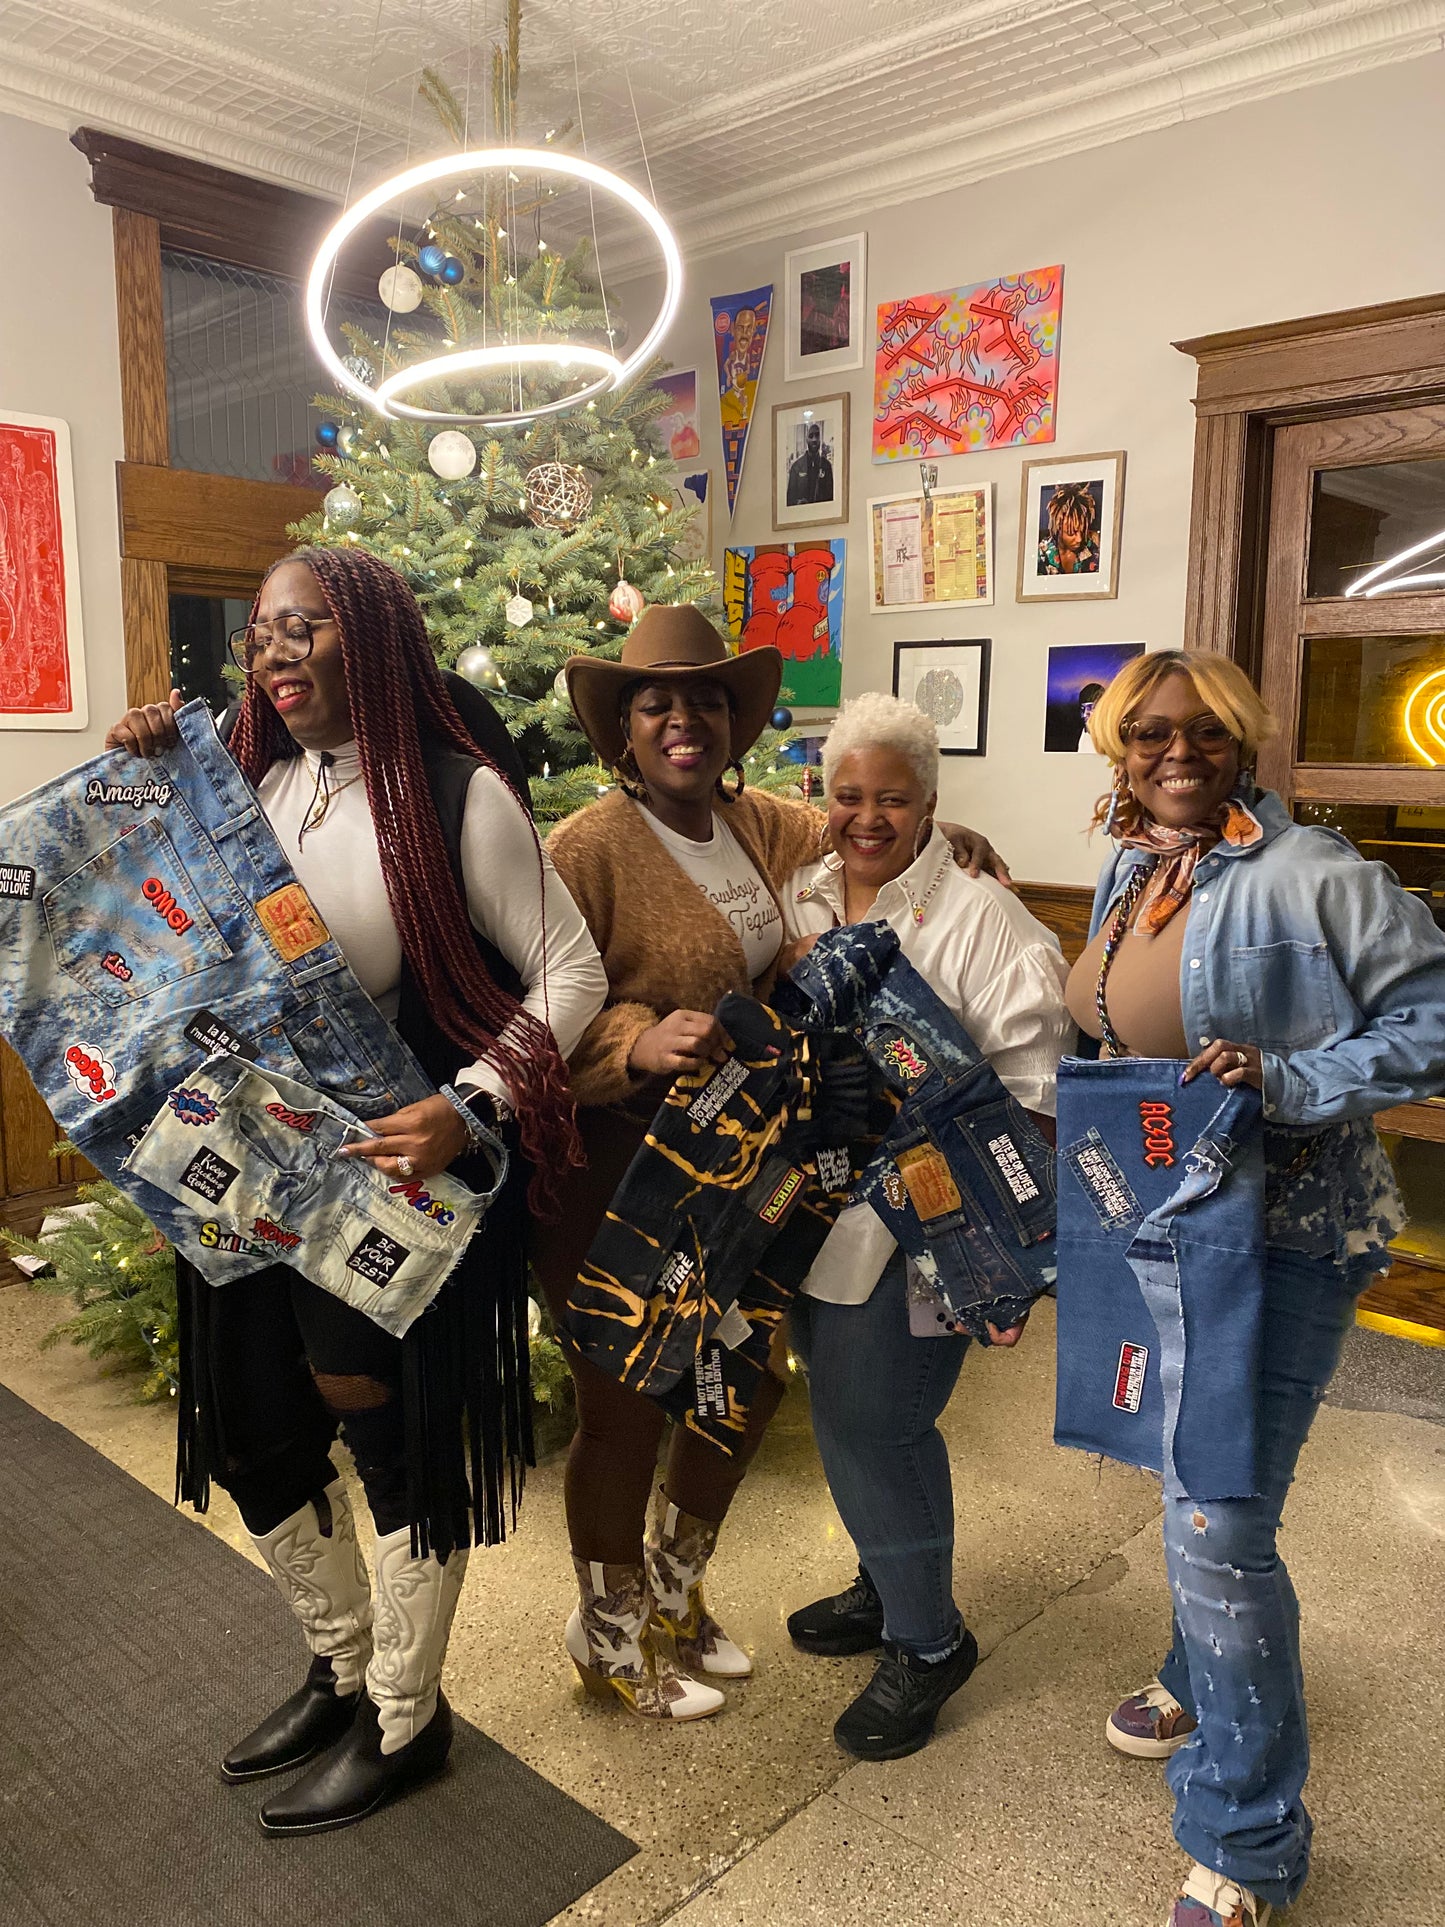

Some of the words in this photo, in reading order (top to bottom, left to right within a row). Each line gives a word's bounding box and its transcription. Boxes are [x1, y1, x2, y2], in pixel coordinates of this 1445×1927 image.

[87, 779, 172, 809] Amazing
[13, 868, 31, 883] LIVE
[0, 880, 9, 893] OU
[9, 881, 29, 896] LOVE
[141, 877, 195, 936] OMG!
[728, 895, 779, 941] Tequil
[200, 1033, 216, 1048] not
[206, 1022, 221, 1038] la
[216, 1029, 232, 1045] la
[227, 1038, 242, 1053] la
[688, 1091, 709, 1115] DIDN'T
[693, 1109, 705, 1122] TO
[700, 1081, 728, 1113] IMPRESS
[265, 1102, 315, 1132] COOL
[698, 1117, 709, 1128] OF
[704, 1107, 717, 1121] YOU
[987, 1138, 1003, 1155] ONLY
[996, 1132, 1015, 1154] HATE
[1081, 1148, 1090, 1157] IN
[198, 1151, 231, 1181] Keep
[994, 1151, 1009, 1167] GOD
[1005, 1148, 1020, 1163] ME
[1010, 1158, 1025, 1173] OR
[1075, 1152, 1094, 1177] KILLED
[1084, 1154, 1095, 1166] MY
[1000, 1163, 1015, 1178] CAN
[1015, 1168, 1034, 1189] LOVE
[1088, 1148, 1102, 1164] MAY
[1097, 1162, 1112, 1181] LOOK
[1106, 1178, 1122, 1198] CALM
[1117, 1195, 1130, 1211] BUT
[1090, 1163, 1104, 1180] HEAD
[184, 1170, 220, 1200] Going
[1005, 1173, 1024, 1195] JUDGE
[1024, 1184, 1039, 1199] ME
[1089, 1175, 1103, 1192] YOU
[1097, 1189, 1105, 1197] 3
[762, 1171, 802, 1220] FASHION
[1015, 1190, 1029, 1204] ME
[1100, 1195, 1117, 1217] TIMES
[1104, 1188, 1124, 1214] ALREADY
[375, 1235, 397, 1254] BE
[357, 1242, 396, 1273] YOUR
[347, 1254, 390, 1285] BEST
[664, 1253, 695, 1294] FIRE
[710, 1348, 722, 1381] EDITION
[1122, 1346, 1133, 1364] BAD
[705, 1371, 715, 1383] I'M
[1115, 1365, 1130, 1405] EXAMPLE
[696, 1386, 707, 1403] NOT
[705, 1385, 716, 1401] BUT
[713, 1383, 726, 1415] LIMITED
